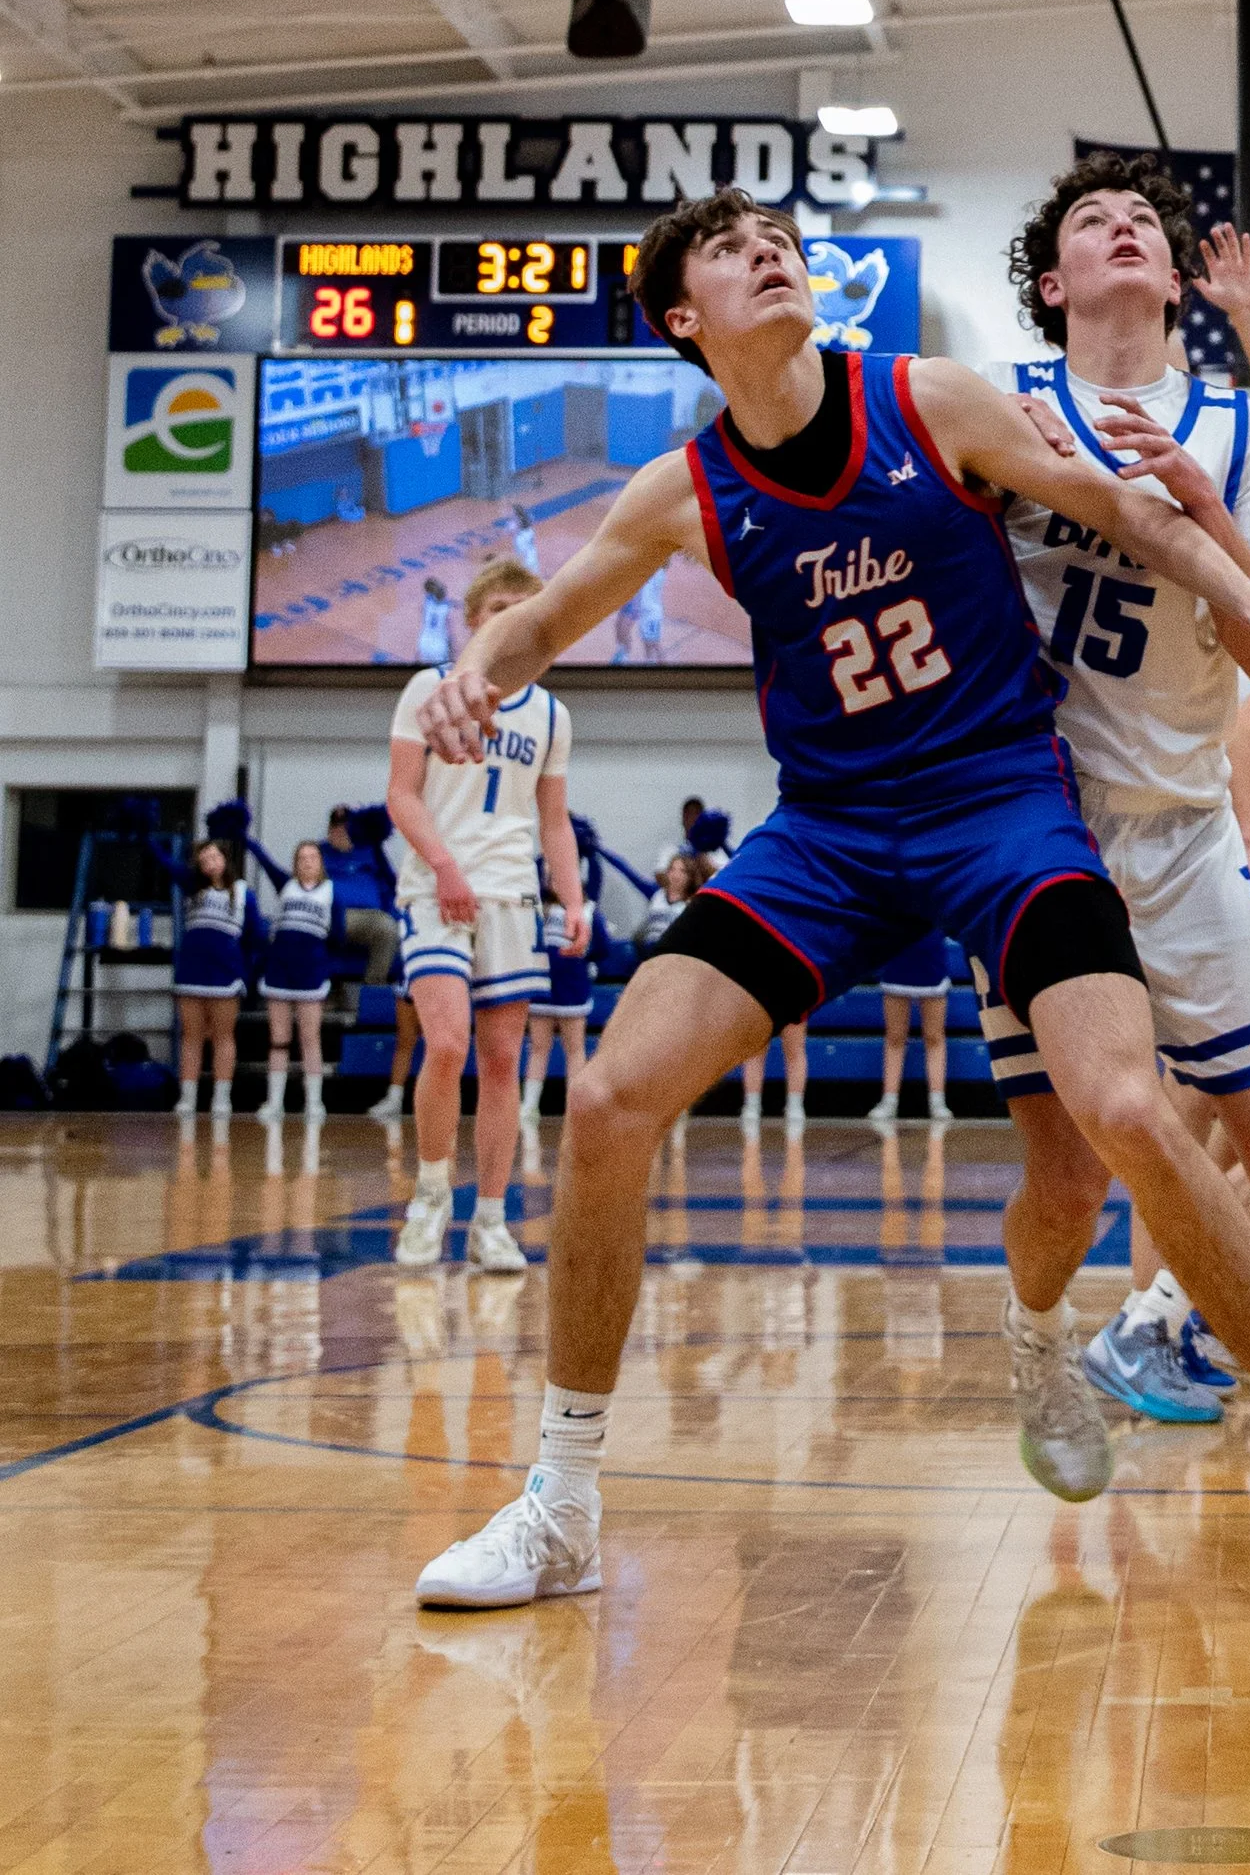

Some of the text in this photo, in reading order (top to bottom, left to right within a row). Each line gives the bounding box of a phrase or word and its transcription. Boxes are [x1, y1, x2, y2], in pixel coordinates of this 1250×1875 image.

[188, 122, 872, 204] HIGHLANDS
[299, 243, 414, 276] HIGHLANDS
[477, 242, 587, 294] 3:21
[309, 286, 375, 338] 26
[452, 304, 556, 345] PERIOD 2
[795, 536, 914, 609] Tribe
[1050, 564, 1157, 679] 15
[819, 595, 952, 717] 22
[483, 765, 502, 814] 1
